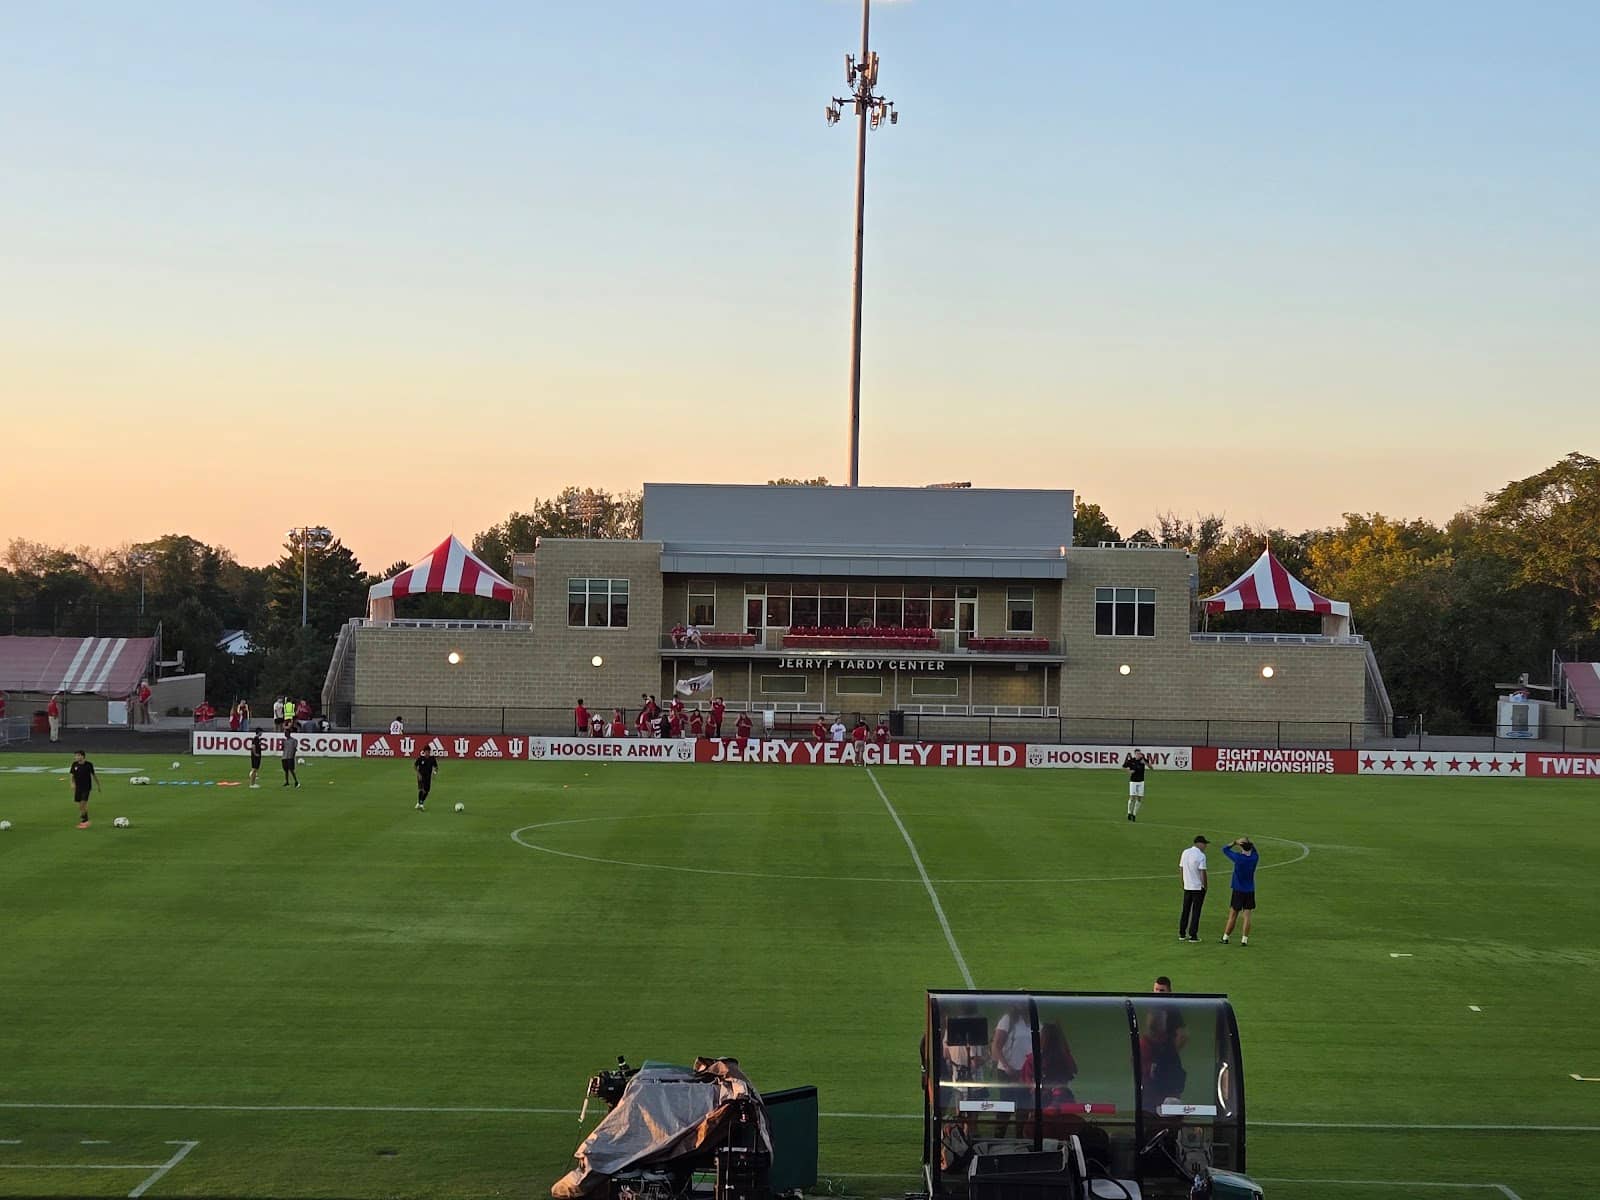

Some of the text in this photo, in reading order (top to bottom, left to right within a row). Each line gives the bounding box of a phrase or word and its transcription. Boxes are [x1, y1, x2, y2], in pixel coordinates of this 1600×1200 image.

[778, 658, 945, 671] JERRY F TARDY CENTER
[197, 736, 357, 752] IUHOOSIES.COM
[550, 743, 622, 757] HOOSIER
[627, 744, 674, 757] ARMY
[475, 750, 503, 758] adidas
[710, 738, 1017, 767] JERRY YEAGLEY FIELD
[1047, 751, 1171, 765] HOOSIER AMY
[1217, 748, 1334, 761] EIGHT NATIONAL
[1215, 760, 1335, 773] CHAMPIONSHIPS
